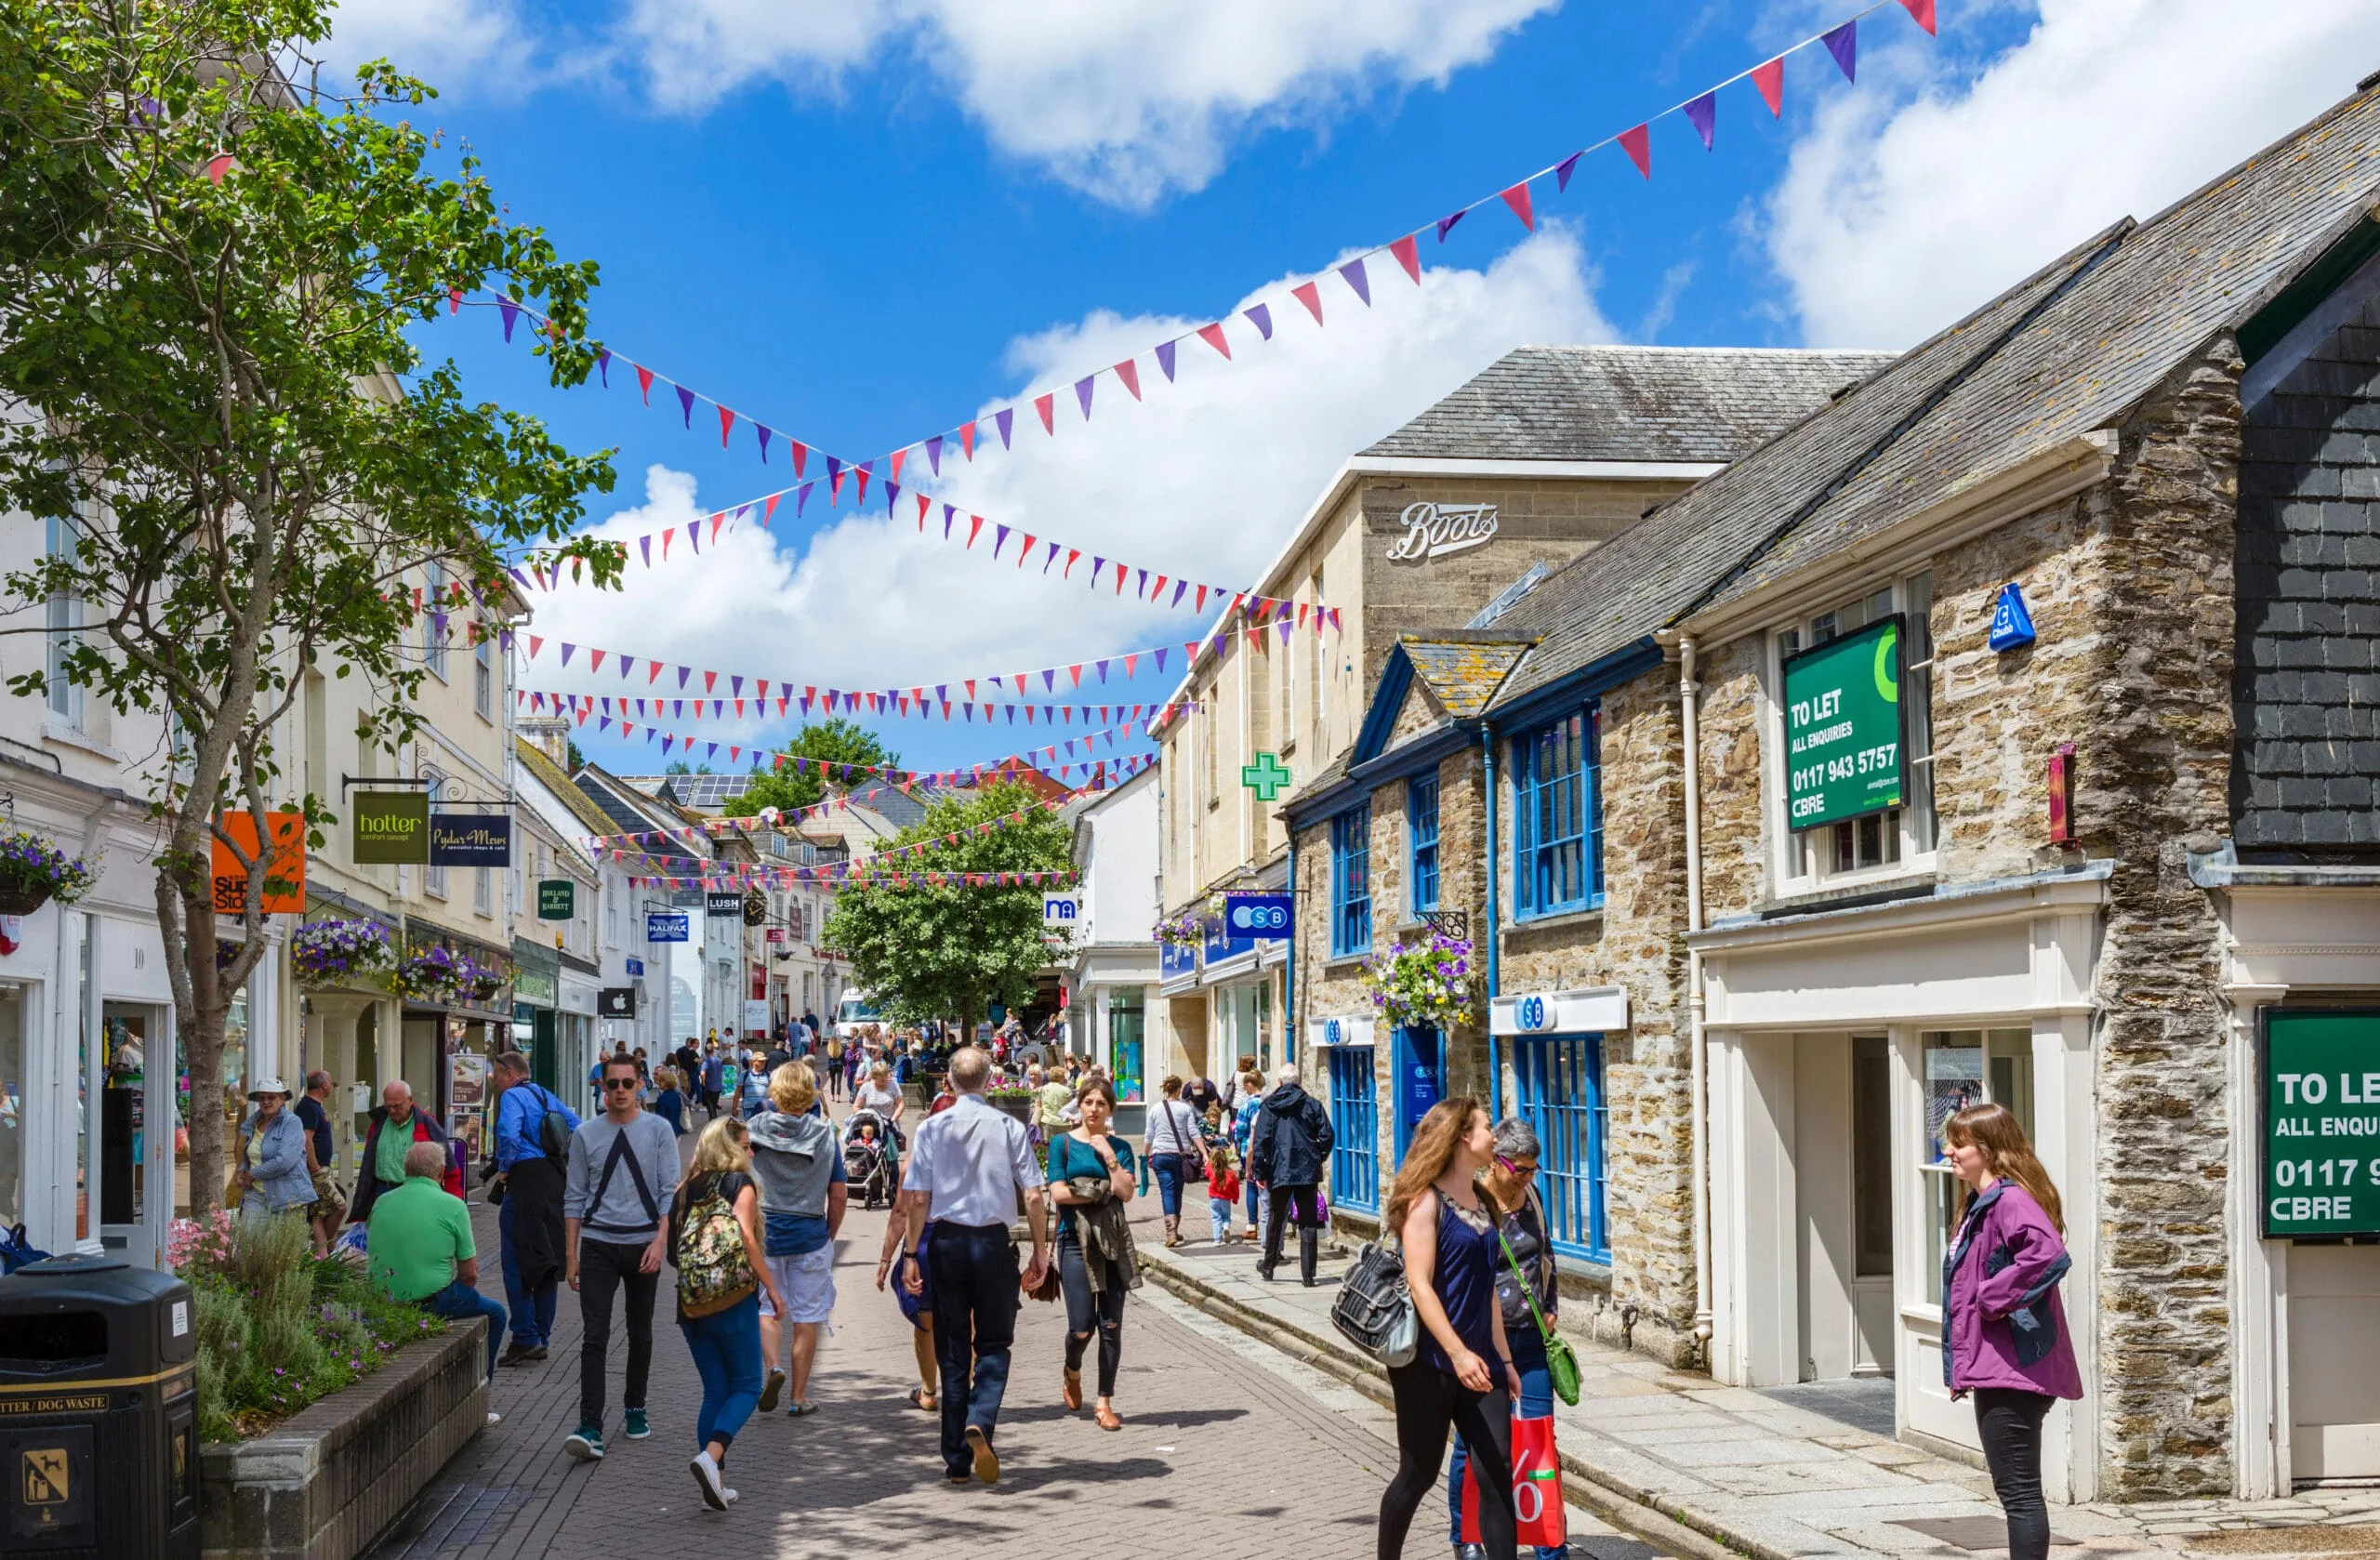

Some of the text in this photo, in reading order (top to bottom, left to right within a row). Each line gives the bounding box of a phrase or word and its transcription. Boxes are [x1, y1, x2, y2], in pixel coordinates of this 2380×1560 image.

[1385, 501, 1499, 560] Boots
[1991, 623, 2014, 640] Chubb
[1791, 688, 1842, 729] TO LET
[1792, 721, 1853, 754] ALL ENQUIRIES
[1792, 743, 1897, 792] 0117 943 5757
[1792, 793, 1825, 818] CBRE
[360, 813, 422, 833] hotter
[386, 834, 409, 842] concept
[433, 828, 507, 850] Pydar Mews
[542, 890, 570, 898] HOLLAND
[708, 899, 739, 909] LUSH
[542, 903, 570, 911] BARRETT
[649, 924, 687, 932] HALIFAX
[135, 947, 144, 970] 10
[2277, 1073, 2380, 1104] TO LE
[2275, 1117, 2314, 1136] ALL
[2275, 1159, 2359, 1187] 0117
[2270, 1196, 2352, 1221] CBRE
[37, 1399, 63, 1411] DOG
[66, 1397, 105, 1408] WASTE
